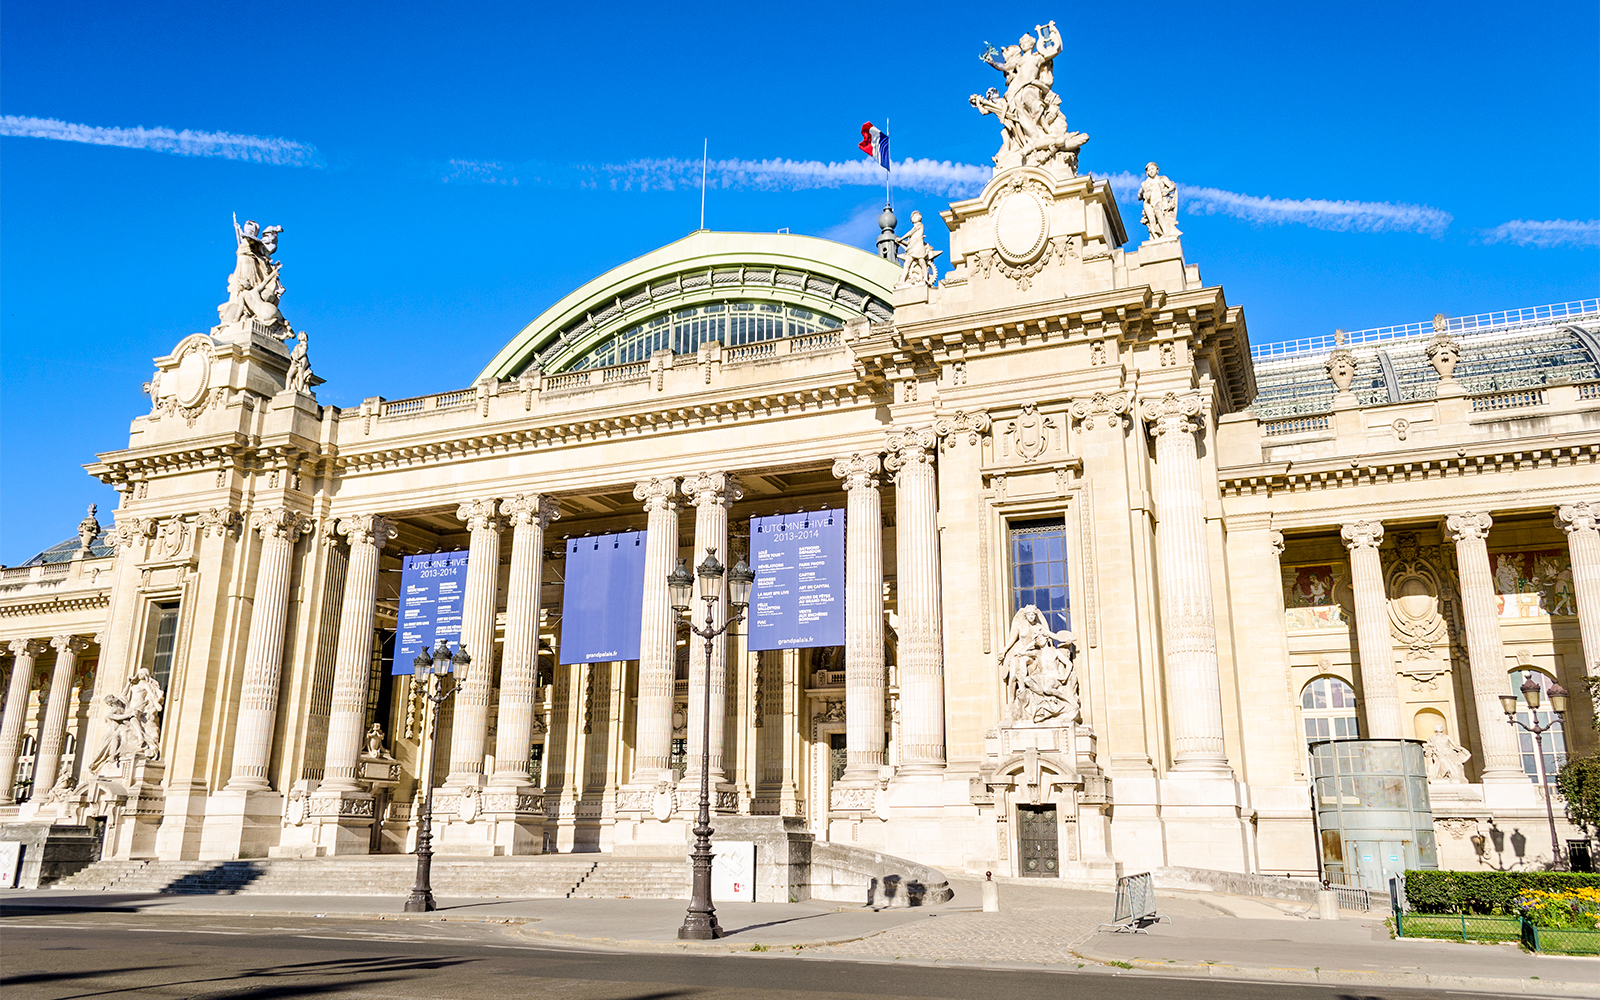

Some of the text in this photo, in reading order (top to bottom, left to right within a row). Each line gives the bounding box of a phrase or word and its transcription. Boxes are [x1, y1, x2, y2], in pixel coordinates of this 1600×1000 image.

[773, 530, 820, 542] 2013-2014
[420, 567, 457, 578] 2013-2014
[778, 636, 814, 646] grandpalais.fr
[585, 650, 618, 660] grandpalais.fr
